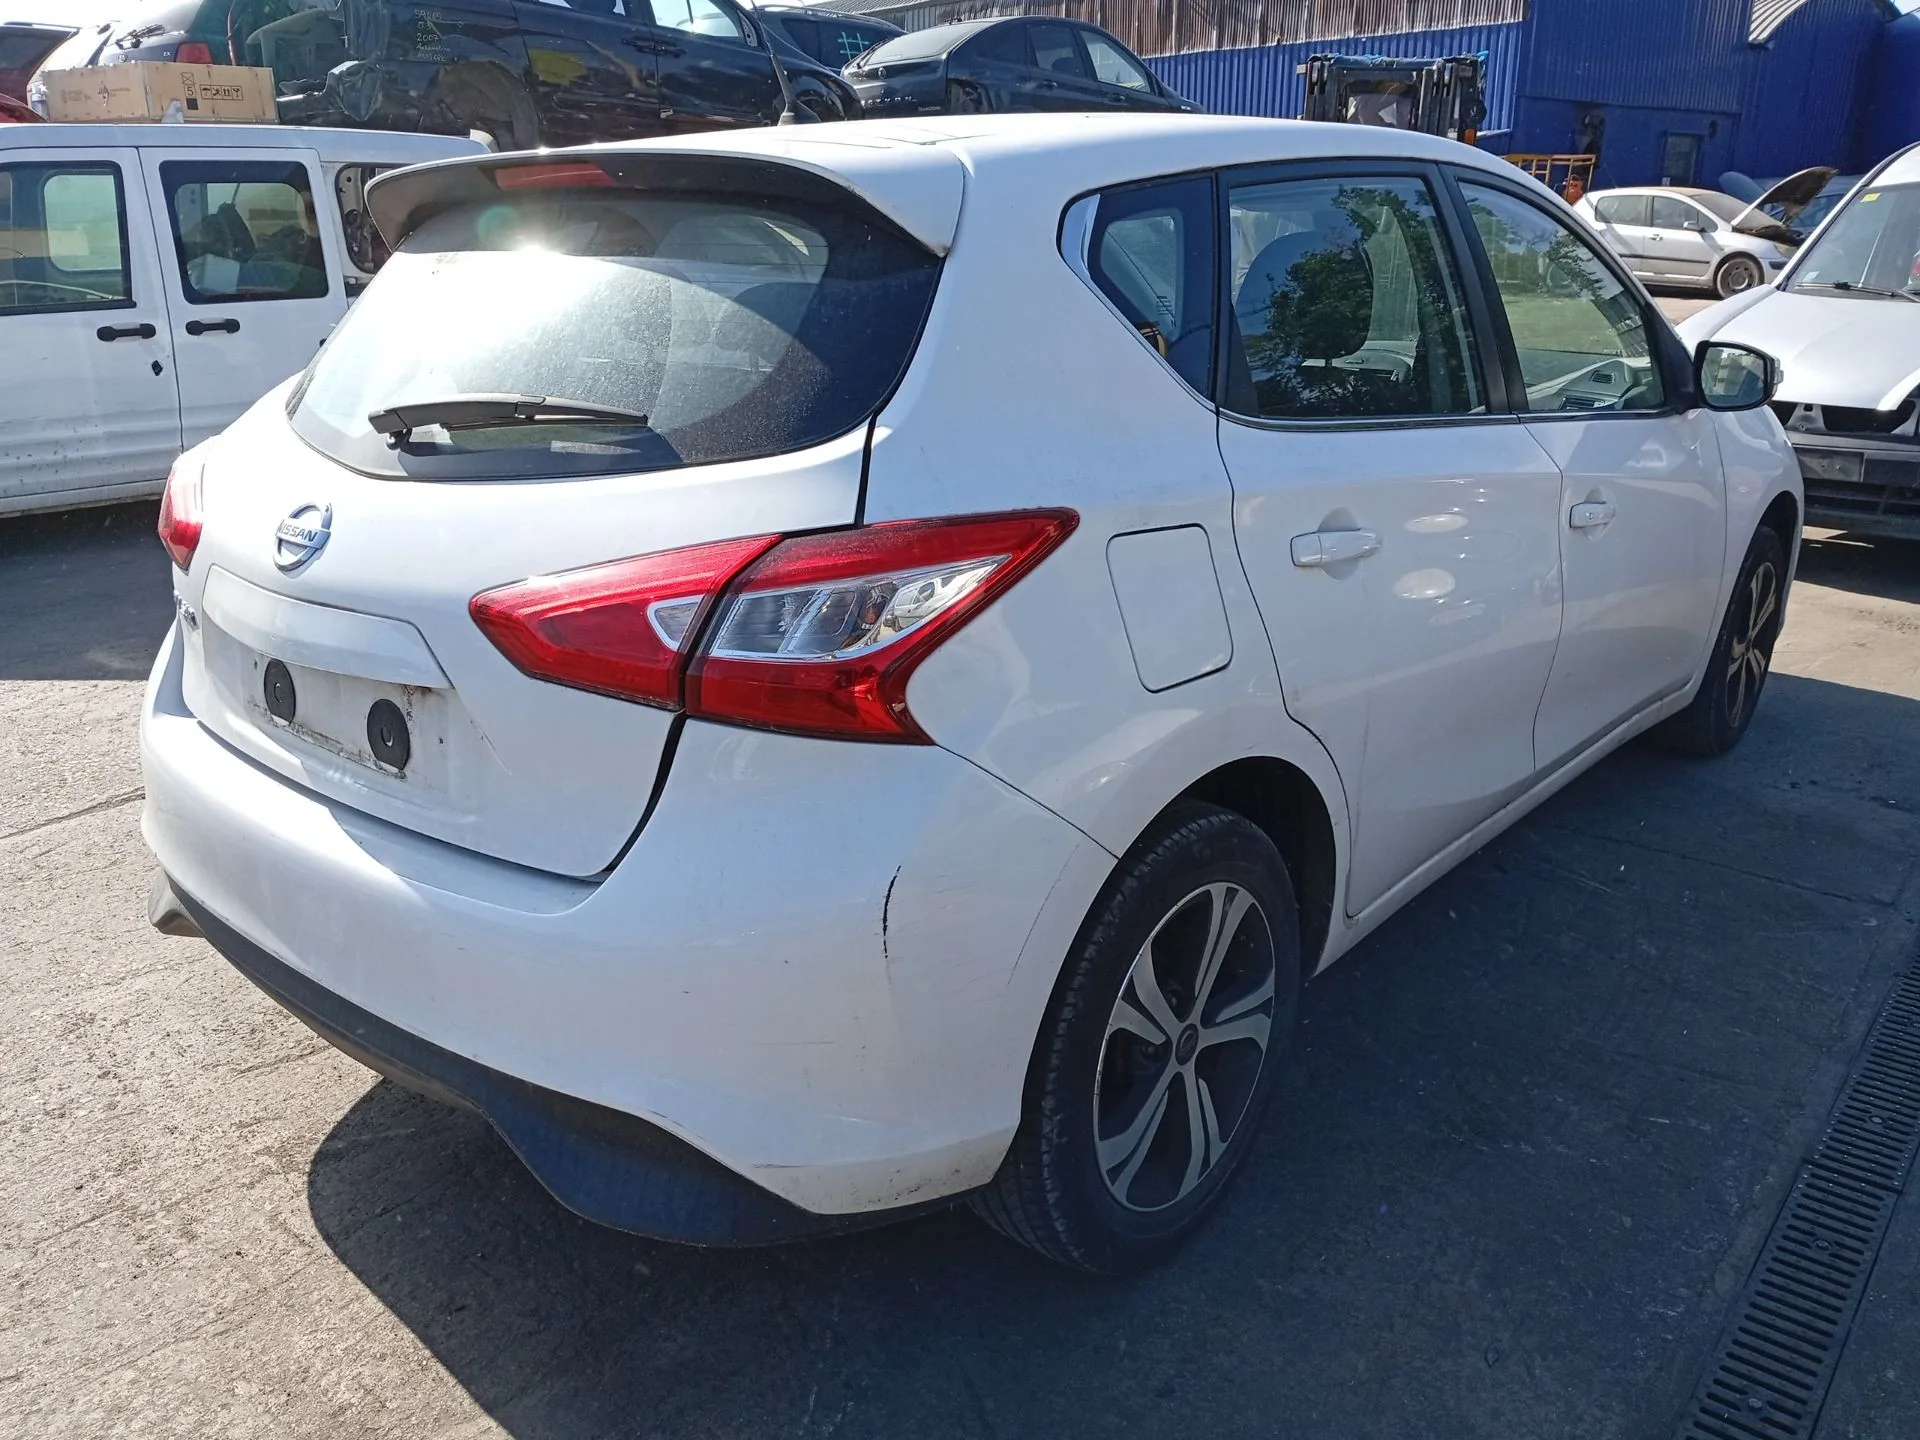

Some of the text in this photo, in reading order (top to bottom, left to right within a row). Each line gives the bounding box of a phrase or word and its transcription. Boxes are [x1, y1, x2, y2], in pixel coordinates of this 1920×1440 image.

[416, 33, 439, 42] 2007
[187, 86, 194, 96] 5
[277, 522, 318, 542] NISSAN
